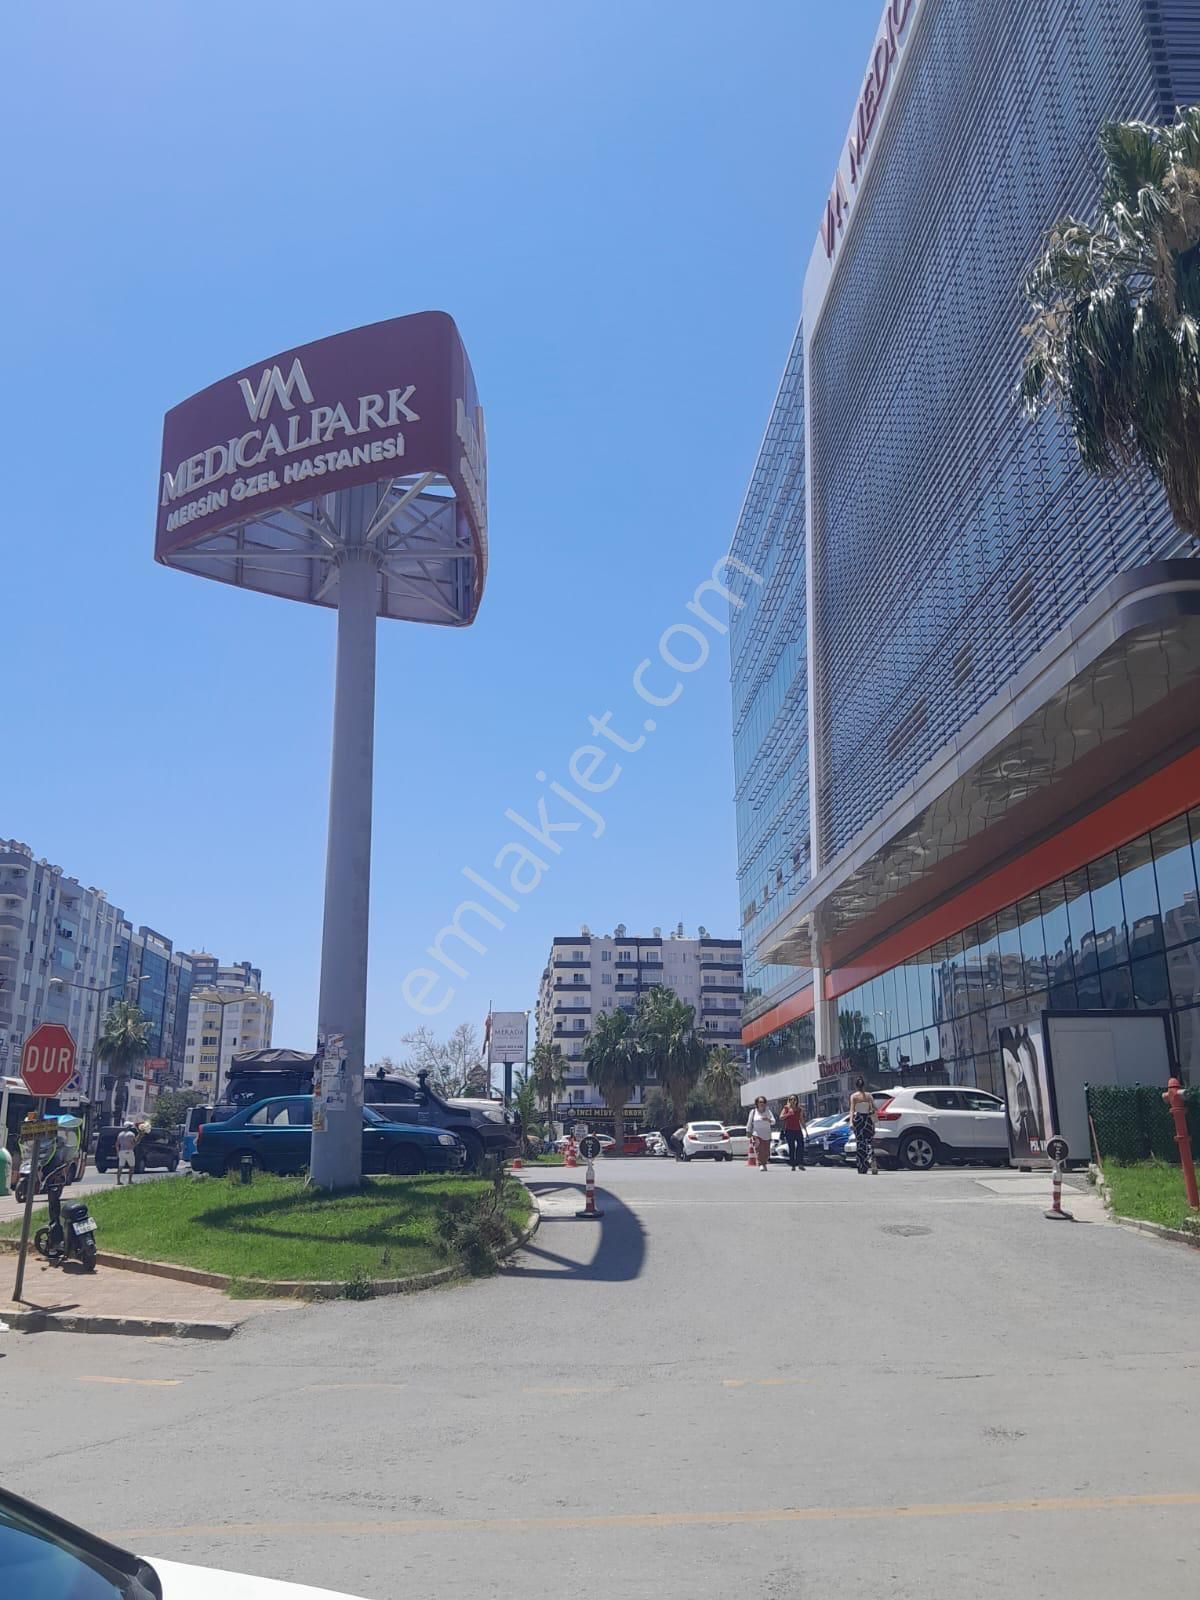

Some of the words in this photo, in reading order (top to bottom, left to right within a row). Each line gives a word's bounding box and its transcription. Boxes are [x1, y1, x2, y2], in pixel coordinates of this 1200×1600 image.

[237, 357, 315, 423] VM
[161, 384, 421, 507] MEDICALPARK
[166, 485, 229, 532] MERSİN
[230, 470, 281, 502] ÖZEL
[283, 432, 406, 486] HASTANESİ
[25, 1045, 72, 1074] DUR
